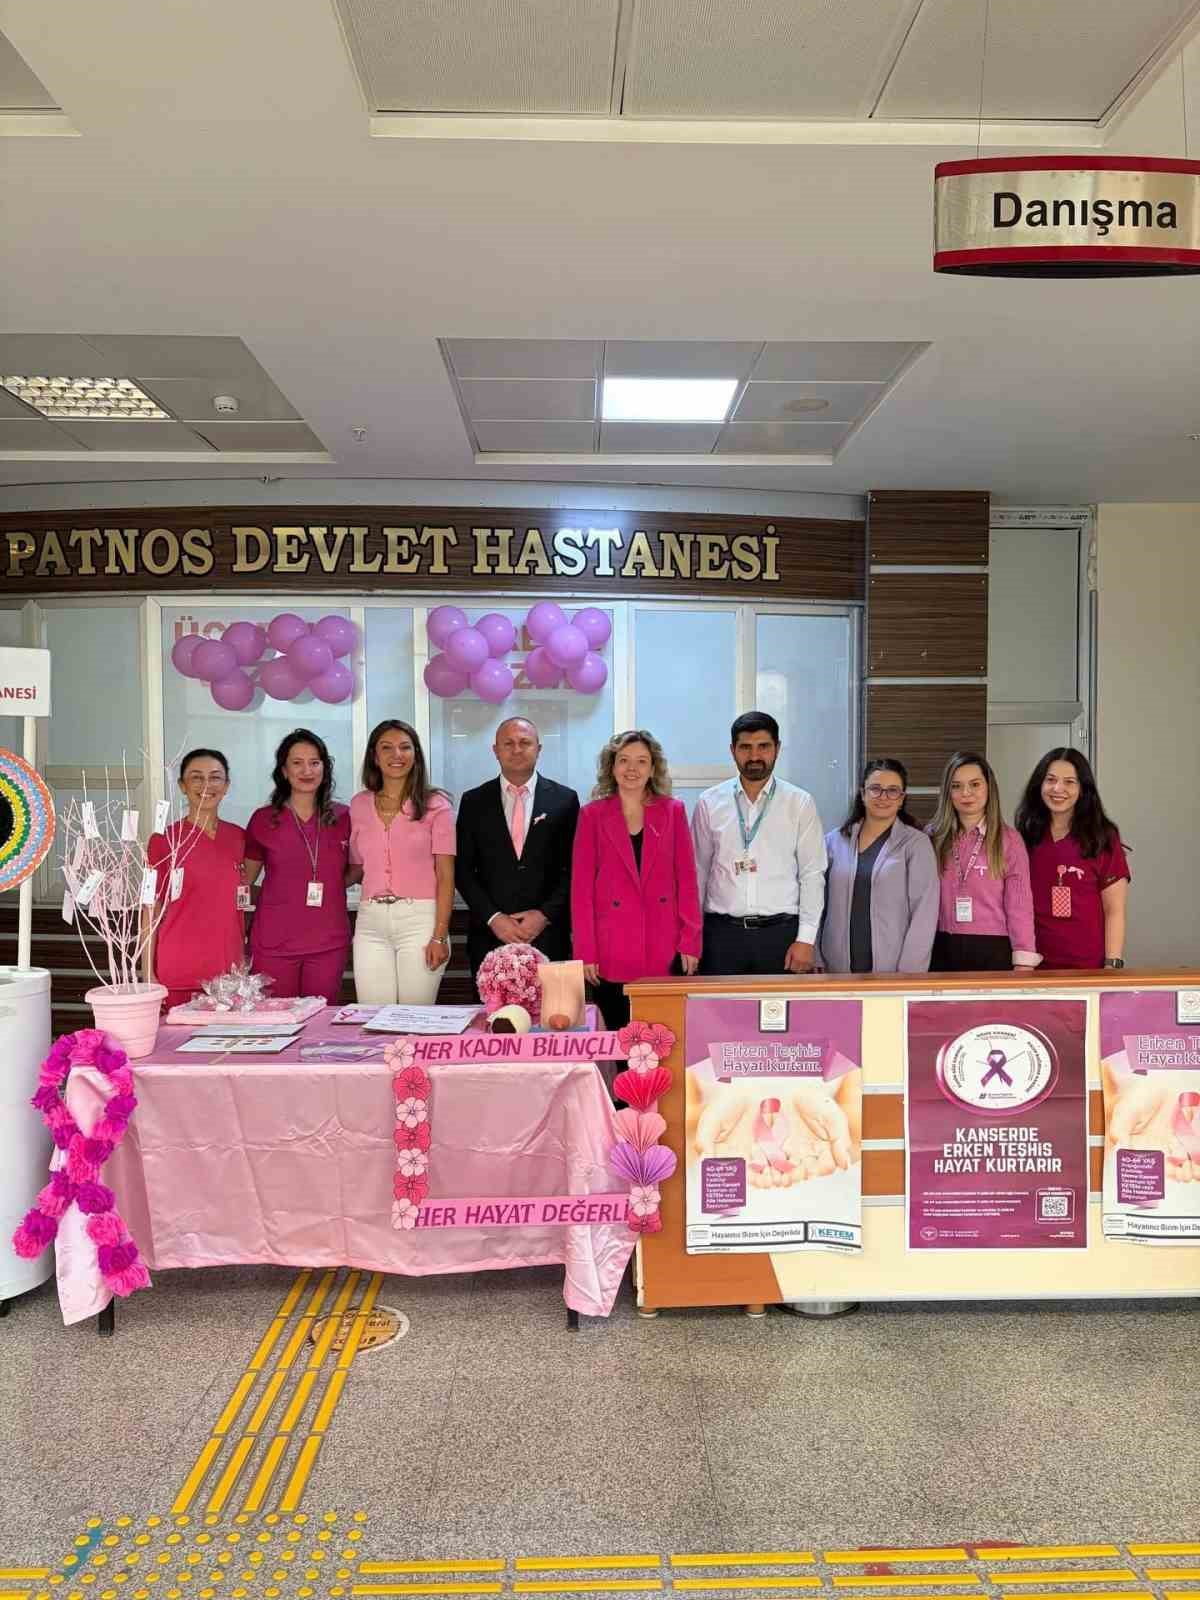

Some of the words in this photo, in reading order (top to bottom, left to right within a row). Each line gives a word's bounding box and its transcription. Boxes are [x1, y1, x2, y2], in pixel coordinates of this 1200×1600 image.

[993, 192, 1177, 236] Danışma
[5, 527, 215, 577] PATNOS
[231, 526, 459, 575] DEVLET
[471, 524, 781, 581] HASTANESİ
[413, 1041, 453, 1061] HER
[459, 1037, 522, 1058] KADIN
[533, 1033, 617, 1060] BİLİNÇLİ
[1137, 1034, 1186, 1050] Erken
[722, 1041, 767, 1057] Erken
[770, 1041, 822, 1062] Teşhis
[1137, 1051, 1184, 1067] Hayat
[722, 1059, 763, 1075] Hayat
[956, 1127, 1039, 1142] KANSERDE
[943, 1143, 993, 1158] ERKEN
[999, 1142, 1052, 1158] TEŞHİS
[934, 1158, 981, 1173] HAYAT
[986, 1158, 1062, 1173] KURTARIR
[414, 1207, 457, 1227] HER
[464, 1203, 536, 1225] HAYAT
[817, 1228, 854, 1241] KETEM
